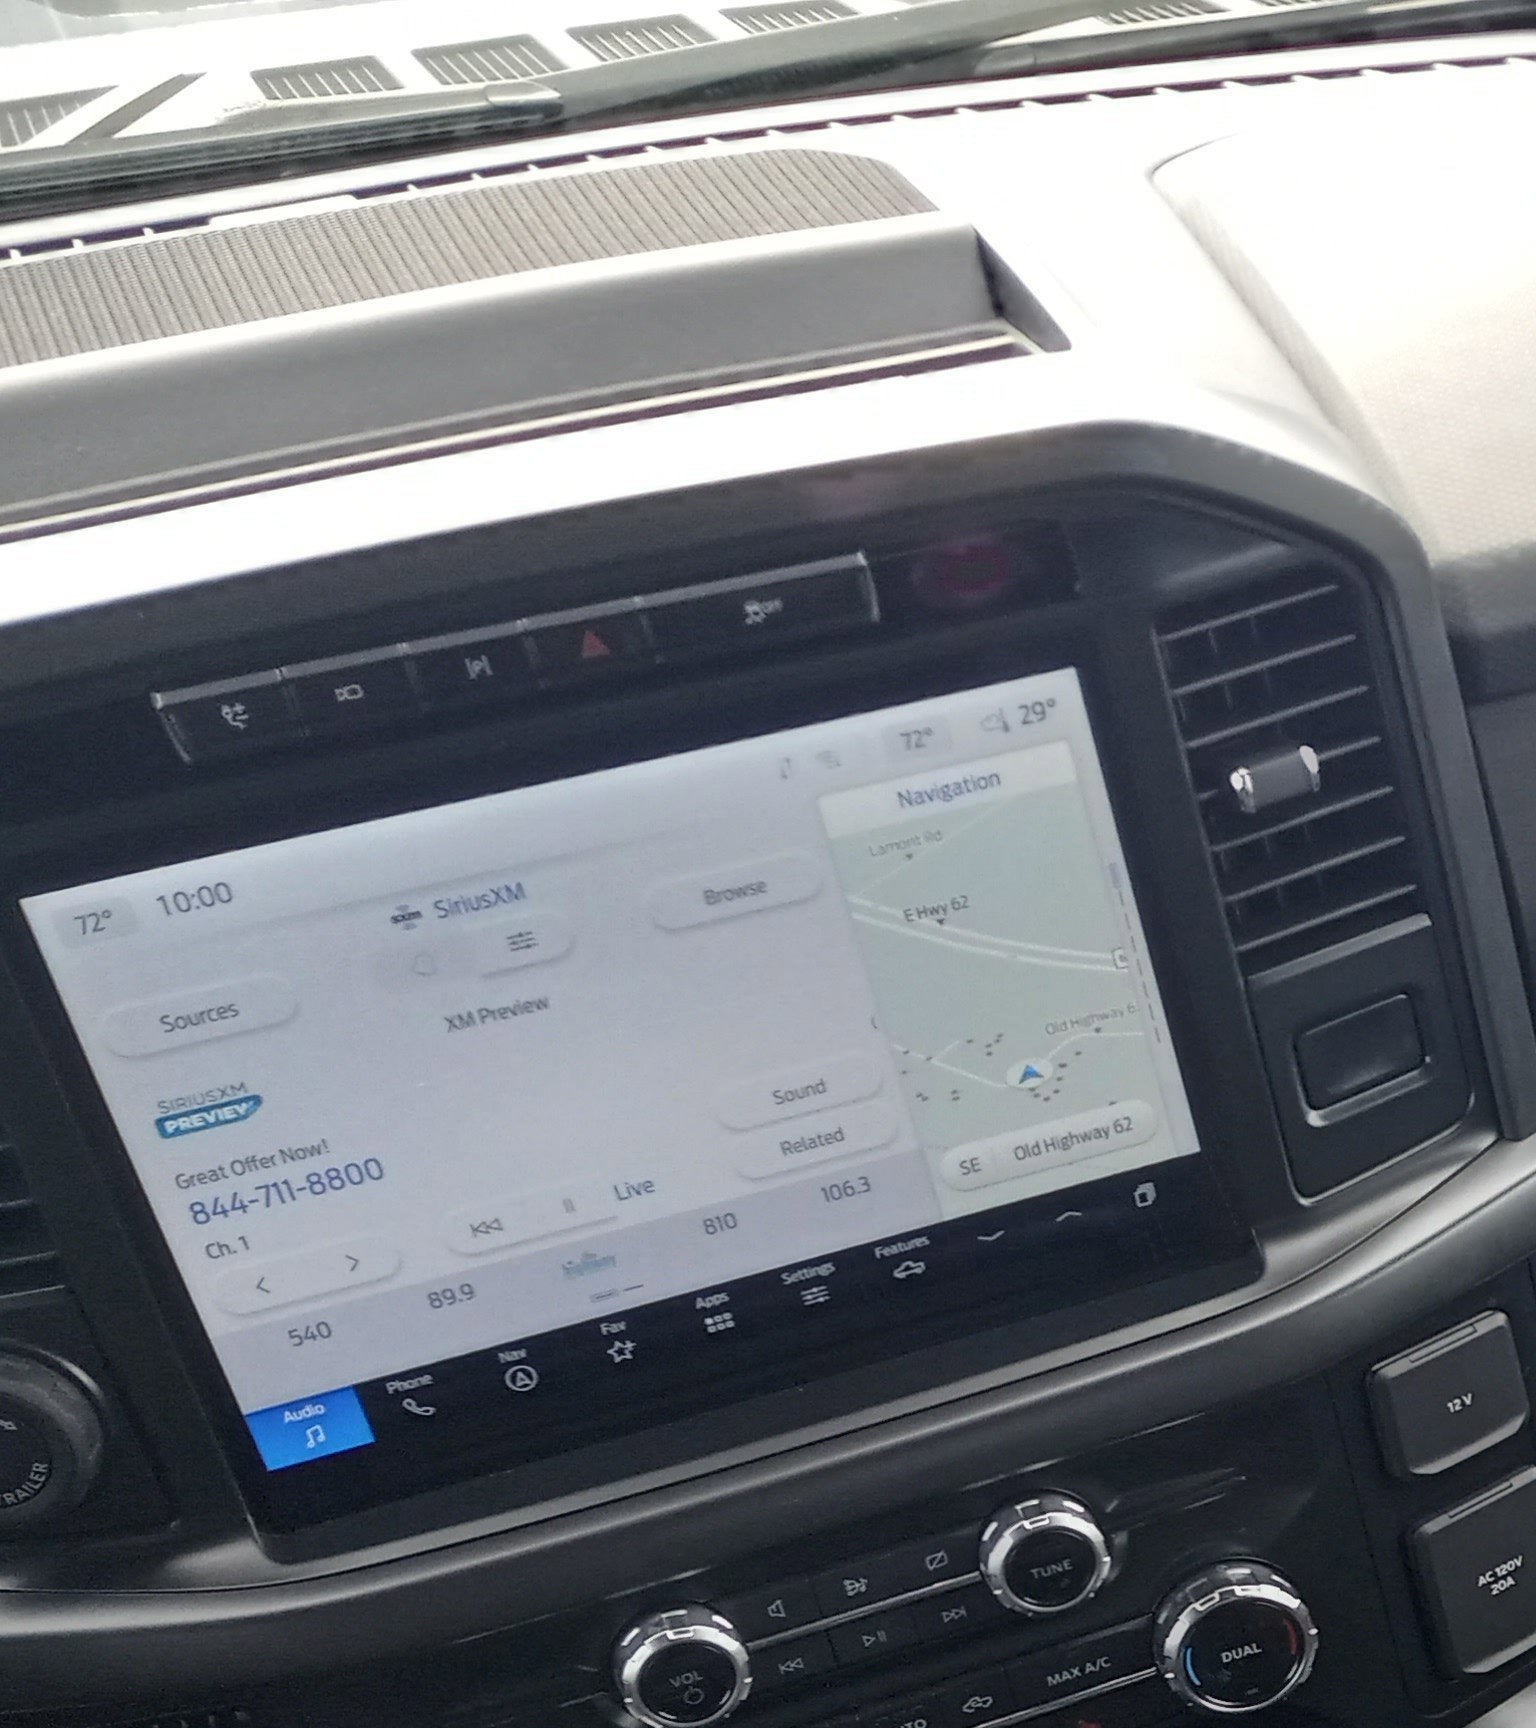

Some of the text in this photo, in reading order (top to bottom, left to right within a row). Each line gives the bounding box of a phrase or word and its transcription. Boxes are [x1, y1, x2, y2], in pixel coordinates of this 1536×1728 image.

[1018, 697, 1057, 726] 29°
[897, 769, 1002, 809] Navigation
[156, 881, 234, 918] 10:00
[433, 880, 528, 919] SiriusXM
[703, 879, 768, 906] Browse
[915, 902, 948, 920] Hwy
[951, 894, 970, 912] 62
[74, 908, 113, 936] 72°
[159, 1000, 240, 1034] Sources
[444, 994, 550, 1034] XM Preview
[157, 1081, 249, 1114] SIRIUSXM
[772, 1078, 828, 1106] Sound
[779, 1127, 846, 1157] Related
[959, 1116, 1134, 1176] SE Old Highway 62
[175, 1138, 331, 1190] Great Offer Now!
[189, 1156, 385, 1225] 844-711-8800
[613, 1175, 657, 1203] Live
[820, 1175, 872, 1203] 106.3
[703, 1212, 738, 1236] 810
[204, 1235, 250, 1260] Ch. 1
[874, 1235, 931, 1259] Features
[780, 1260, 836, 1287] Settings
[427, 1282, 475, 1310] 89.9
[695, 1290, 730, 1312] Apps
[287, 1320, 333, 1348] 540
[600, 1318, 627, 1337] Fav
[497, 1346, 528, 1365] Nav
[386, 1371, 434, 1395] Phone
[282, 1400, 327, 1425] Audio
[1028, 1557, 1074, 1581] TUNE
[1477, 1555, 1525, 1588] AC 120V
[1219, 1641, 1263, 1664] DUAL
[1046, 1655, 1113, 1688] MAX A/C
